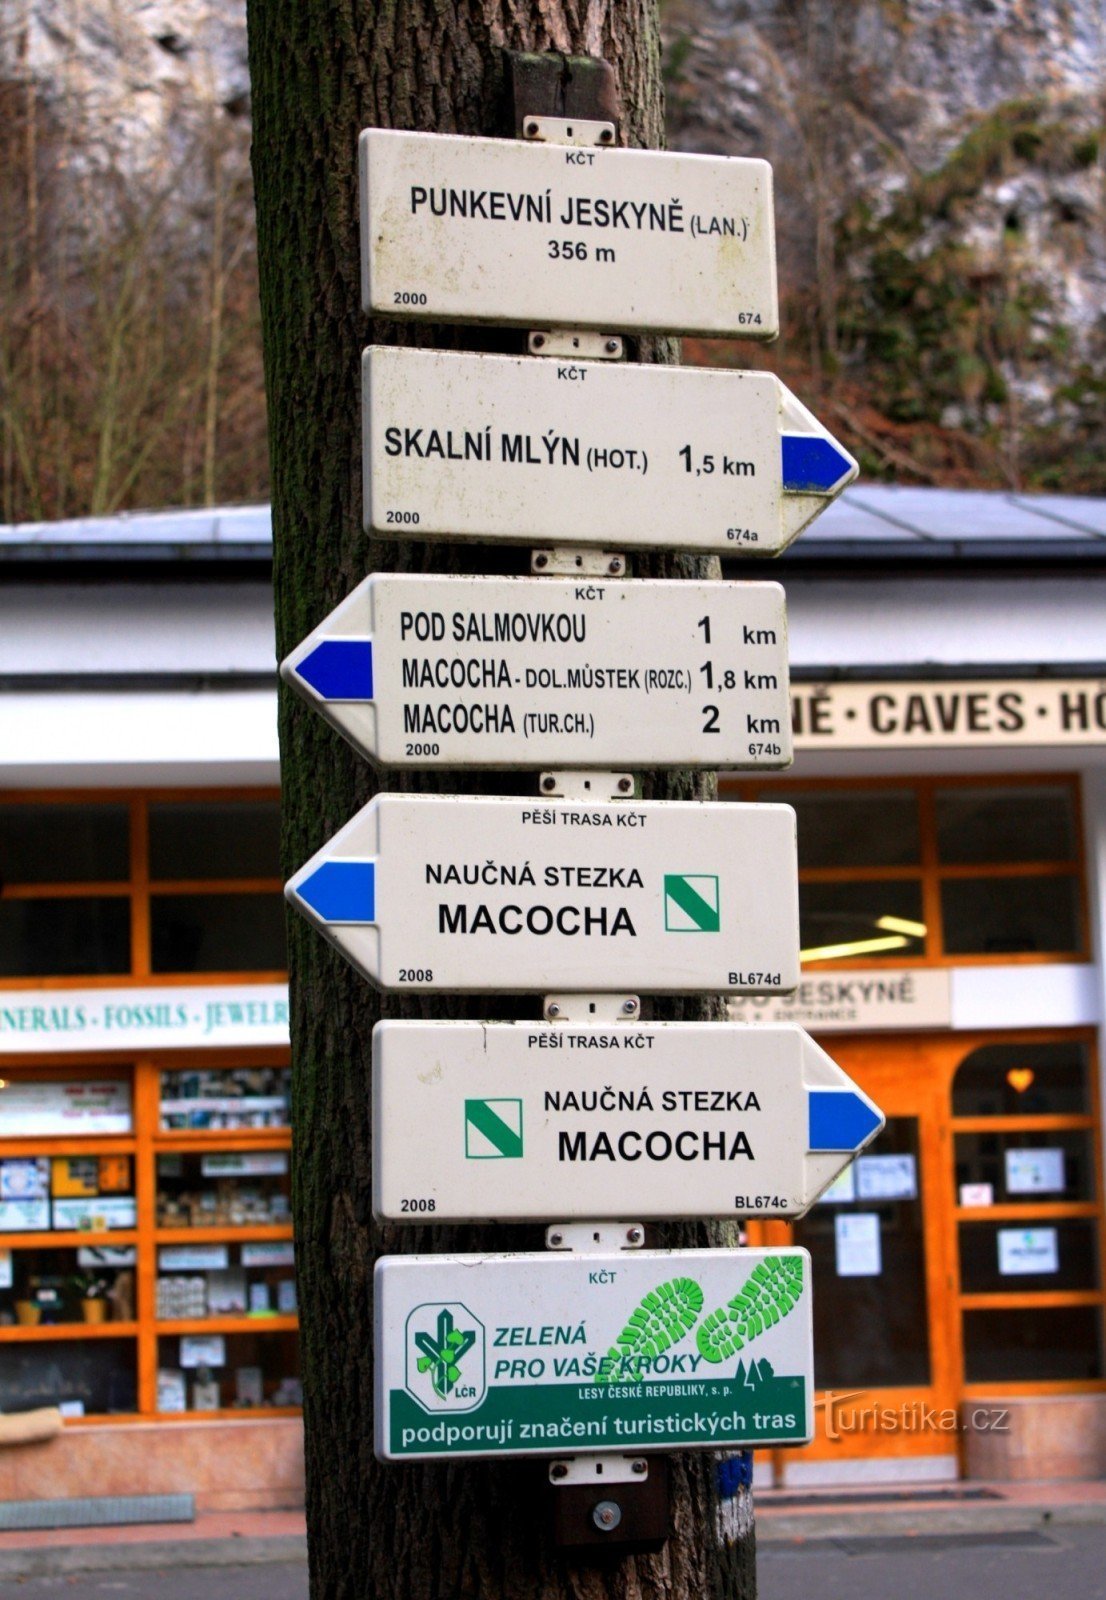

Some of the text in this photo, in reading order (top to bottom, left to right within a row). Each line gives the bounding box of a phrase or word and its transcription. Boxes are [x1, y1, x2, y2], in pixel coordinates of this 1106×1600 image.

[566, 150, 595, 165] KČT
[411, 186, 747, 242] PUNKEVNÍ JESKYNĚ (LAN.)
[548, 239, 616, 262] 356 m
[393, 291, 427, 305] 2000
[738, 312, 762, 325] 674
[557, 366, 587, 381] KČT
[384, 425, 755, 476] SKALNÍ MLÝN (HOT.) 1,5 km
[386, 510, 420, 525] 2000
[726, 528, 759, 542] 674a
[575, 586, 605, 600] KČT
[401, 611, 777, 645] POD SALMOVKOU 1 km
[402, 658, 512, 689] MACOCHA
[644, 669, 692, 694] (ROZC.)
[700, 660, 736, 692] 1,8
[744, 670, 778, 690] km
[403, 703, 780, 738] MACOCHA (TUR.CH.) 2 km
[868, 691, 1025, 735] CAVES
[405, 743, 440, 756] 2000
[748, 743, 782, 756] 674b
[522, 810, 647, 827] PĚŠÍ TRASA KČT
[425, 861, 644, 889] NAUČNÁ STEZKA
[438, 903, 637, 937] MACOCHA
[398, 969, 434, 982] 2008
[728, 972, 781, 986] BL674d
[104, 1001, 188, 1029] FOSSILS
[528, 1033, 655, 1049] PĚŠÍ TRASA KČT
[544, 1085, 761, 1112] NAUČNÁ STEZKA
[558, 1130, 755, 1162] MACOCHA
[400, 1199, 436, 1213] 2008
[734, 1195, 788, 1209] BL674c
[589, 1269, 617, 1284] KČT
[493, 1320, 587, 1347] ZELENÁ
[494, 1352, 704, 1379] PRO VAŠE KROKY
[454, 1386, 477, 1398] LČR
[578, 1383, 733, 1400] LESY ČESKÉ REPUBLIKY, s. p.
[402, 1410, 796, 1447] podporují značení turistických tras
